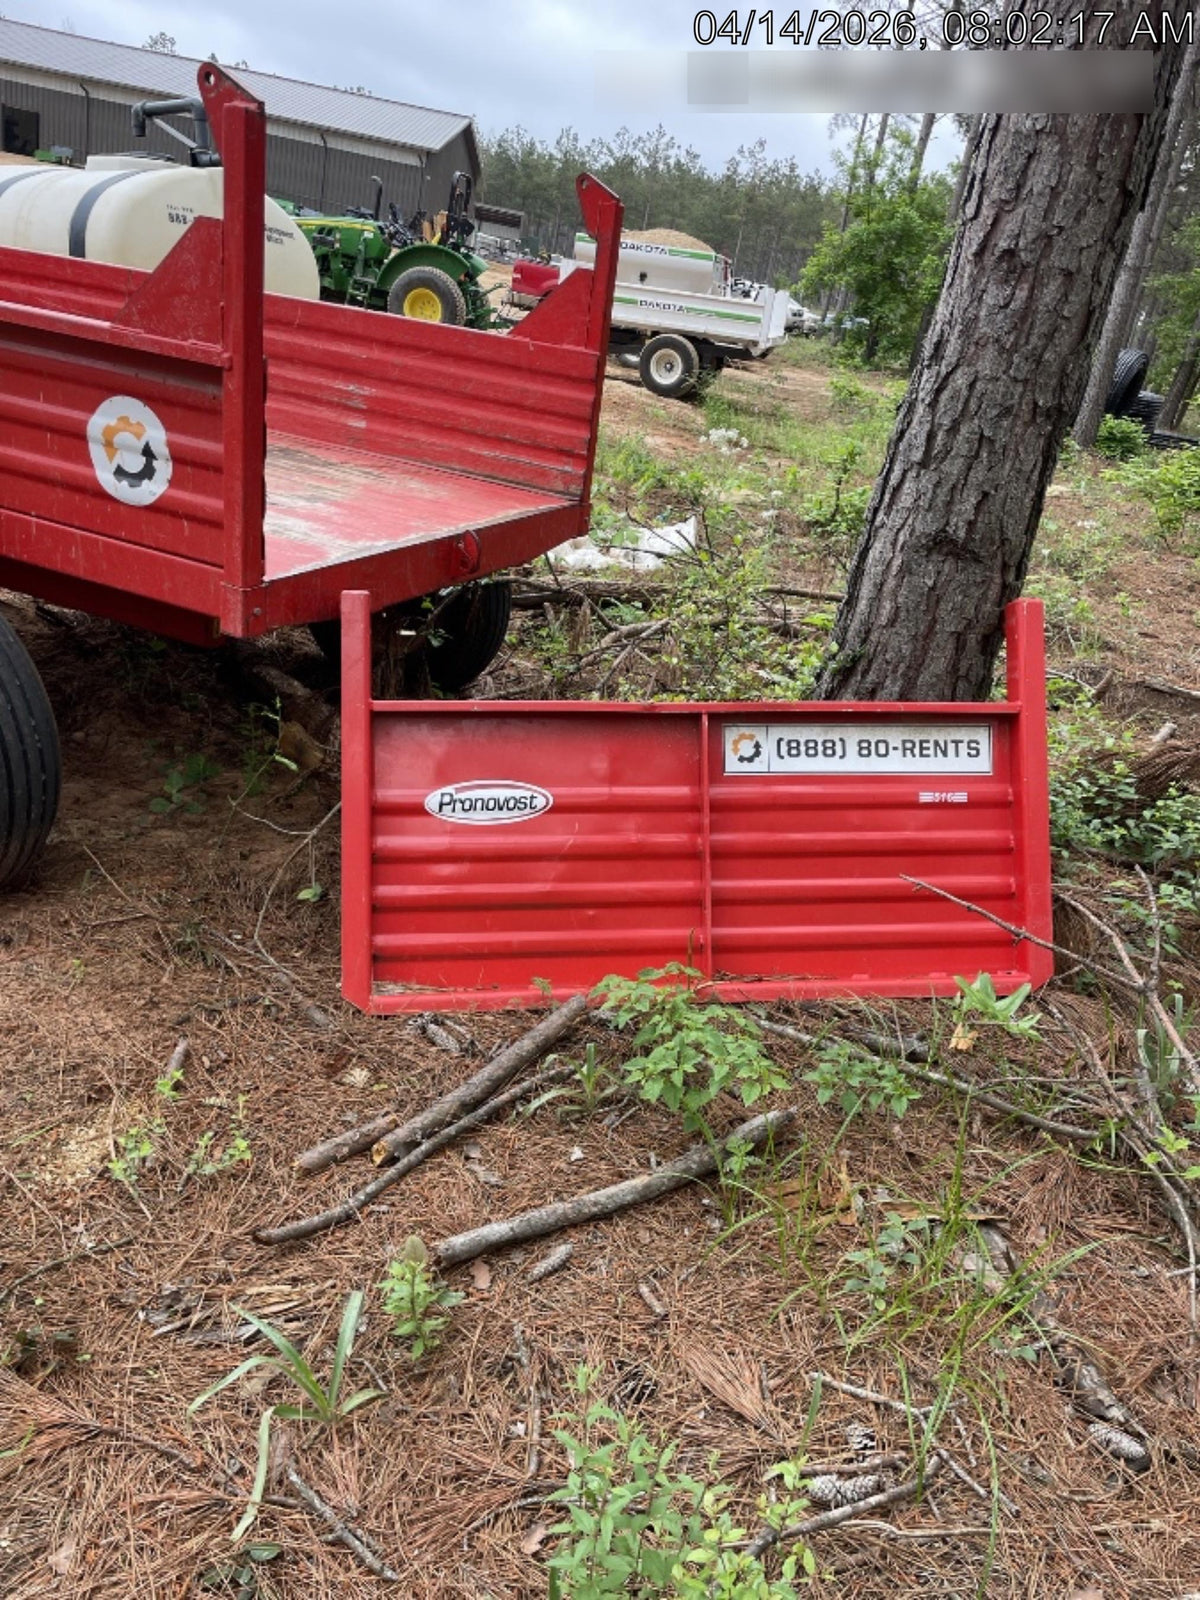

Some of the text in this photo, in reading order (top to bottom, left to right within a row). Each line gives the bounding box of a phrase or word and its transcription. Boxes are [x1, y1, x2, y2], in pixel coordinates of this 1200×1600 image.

[620, 241, 667, 254] DAKOTA
[639, 300, 684, 312] DAKOTA
[776, 737, 981, 760] (888) 80-RENTS
[438, 792, 538, 813] Pronovost
